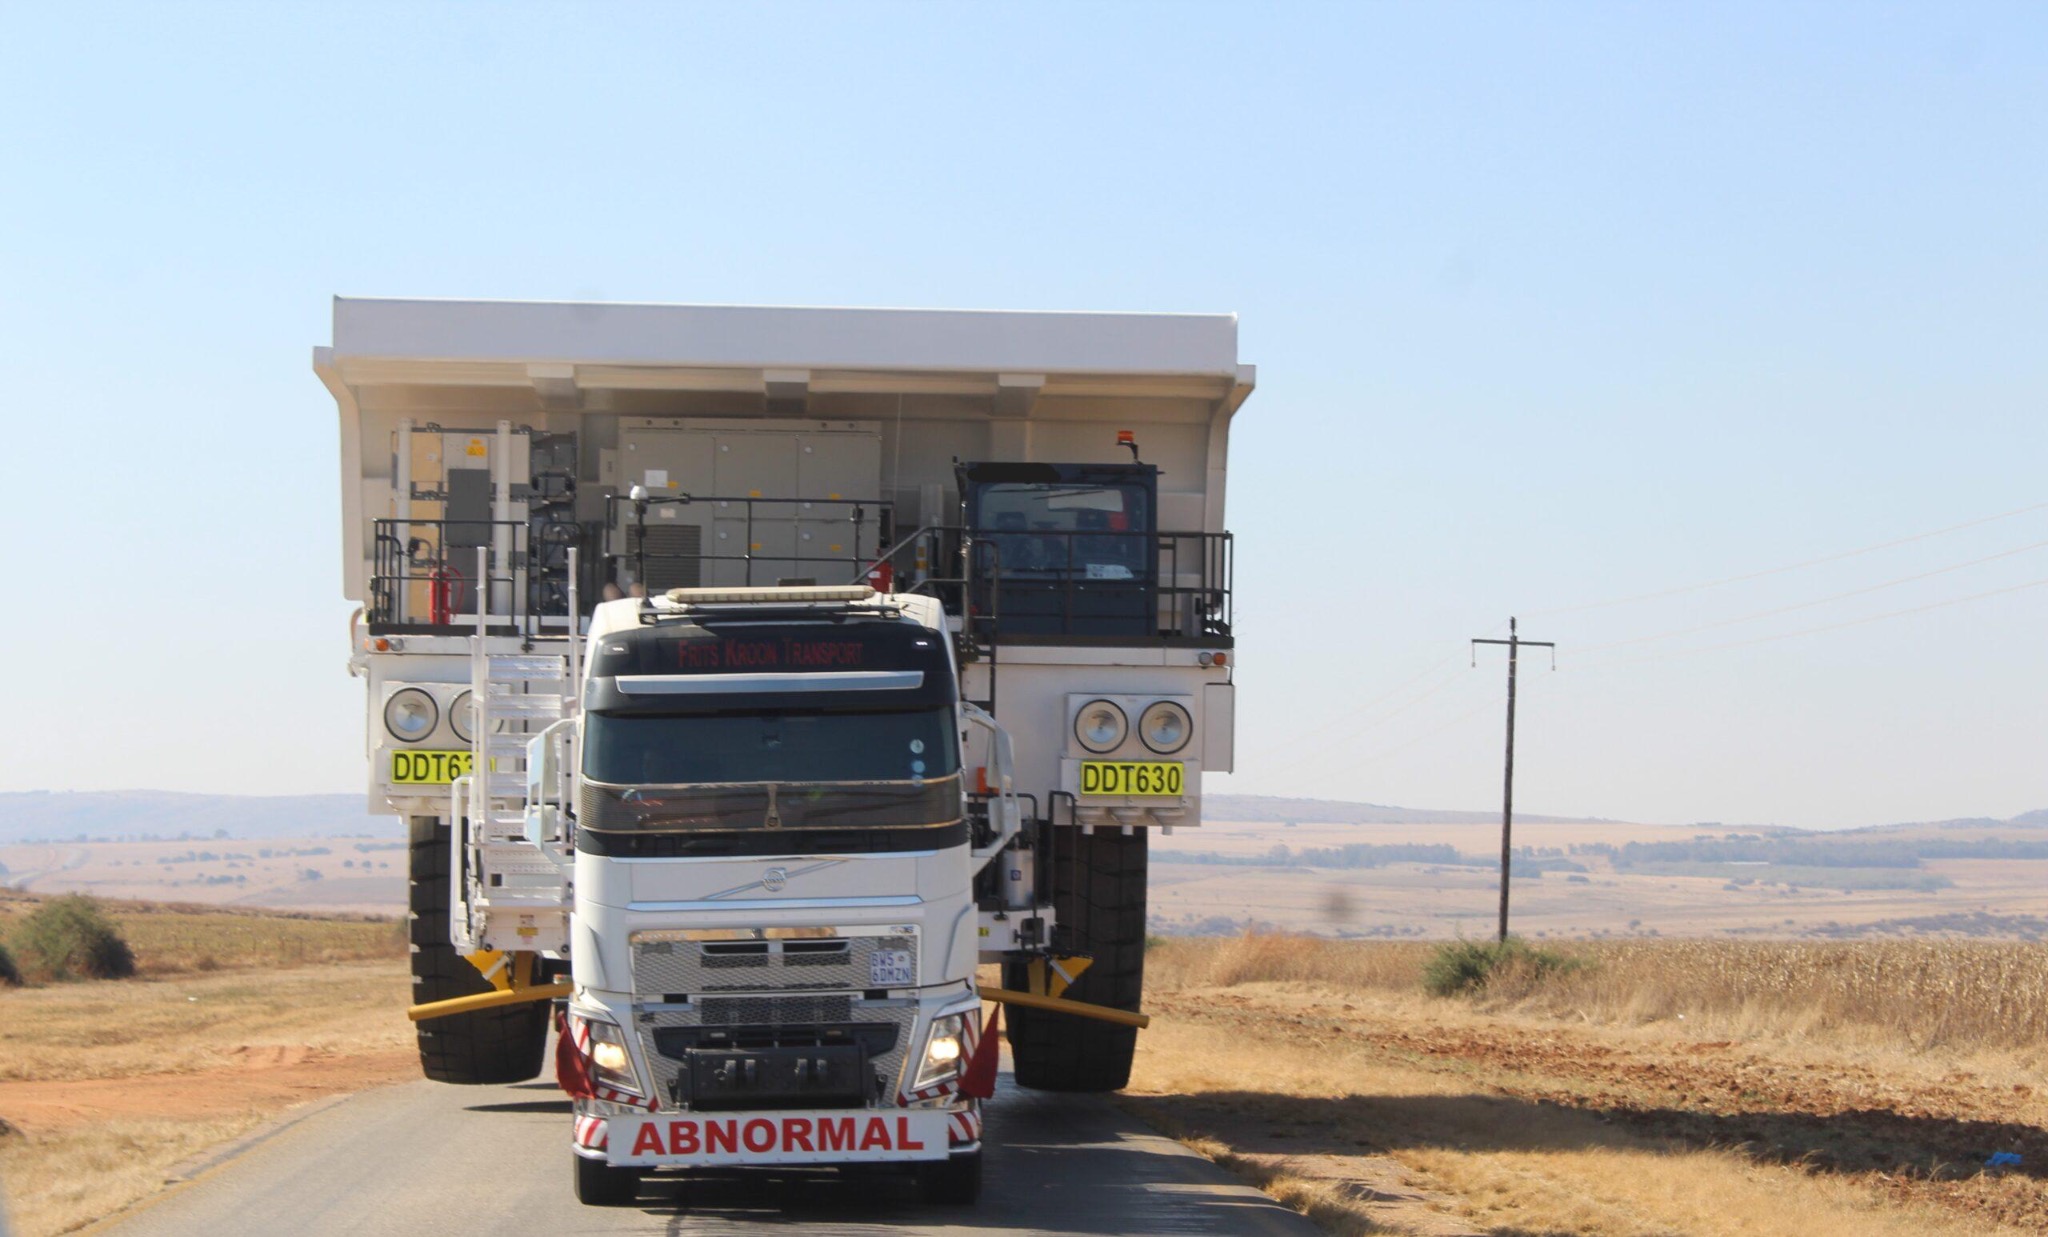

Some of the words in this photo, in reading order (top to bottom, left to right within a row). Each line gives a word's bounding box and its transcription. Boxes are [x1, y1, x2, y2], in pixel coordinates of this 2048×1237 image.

[678, 639, 720, 668] FRITS
[783, 638, 864, 665] TRANSPORT
[394, 753, 473, 781] DDT6
[1083, 764, 1180, 793] DDT630
[631, 1116, 925, 1157] ABNORMAL
